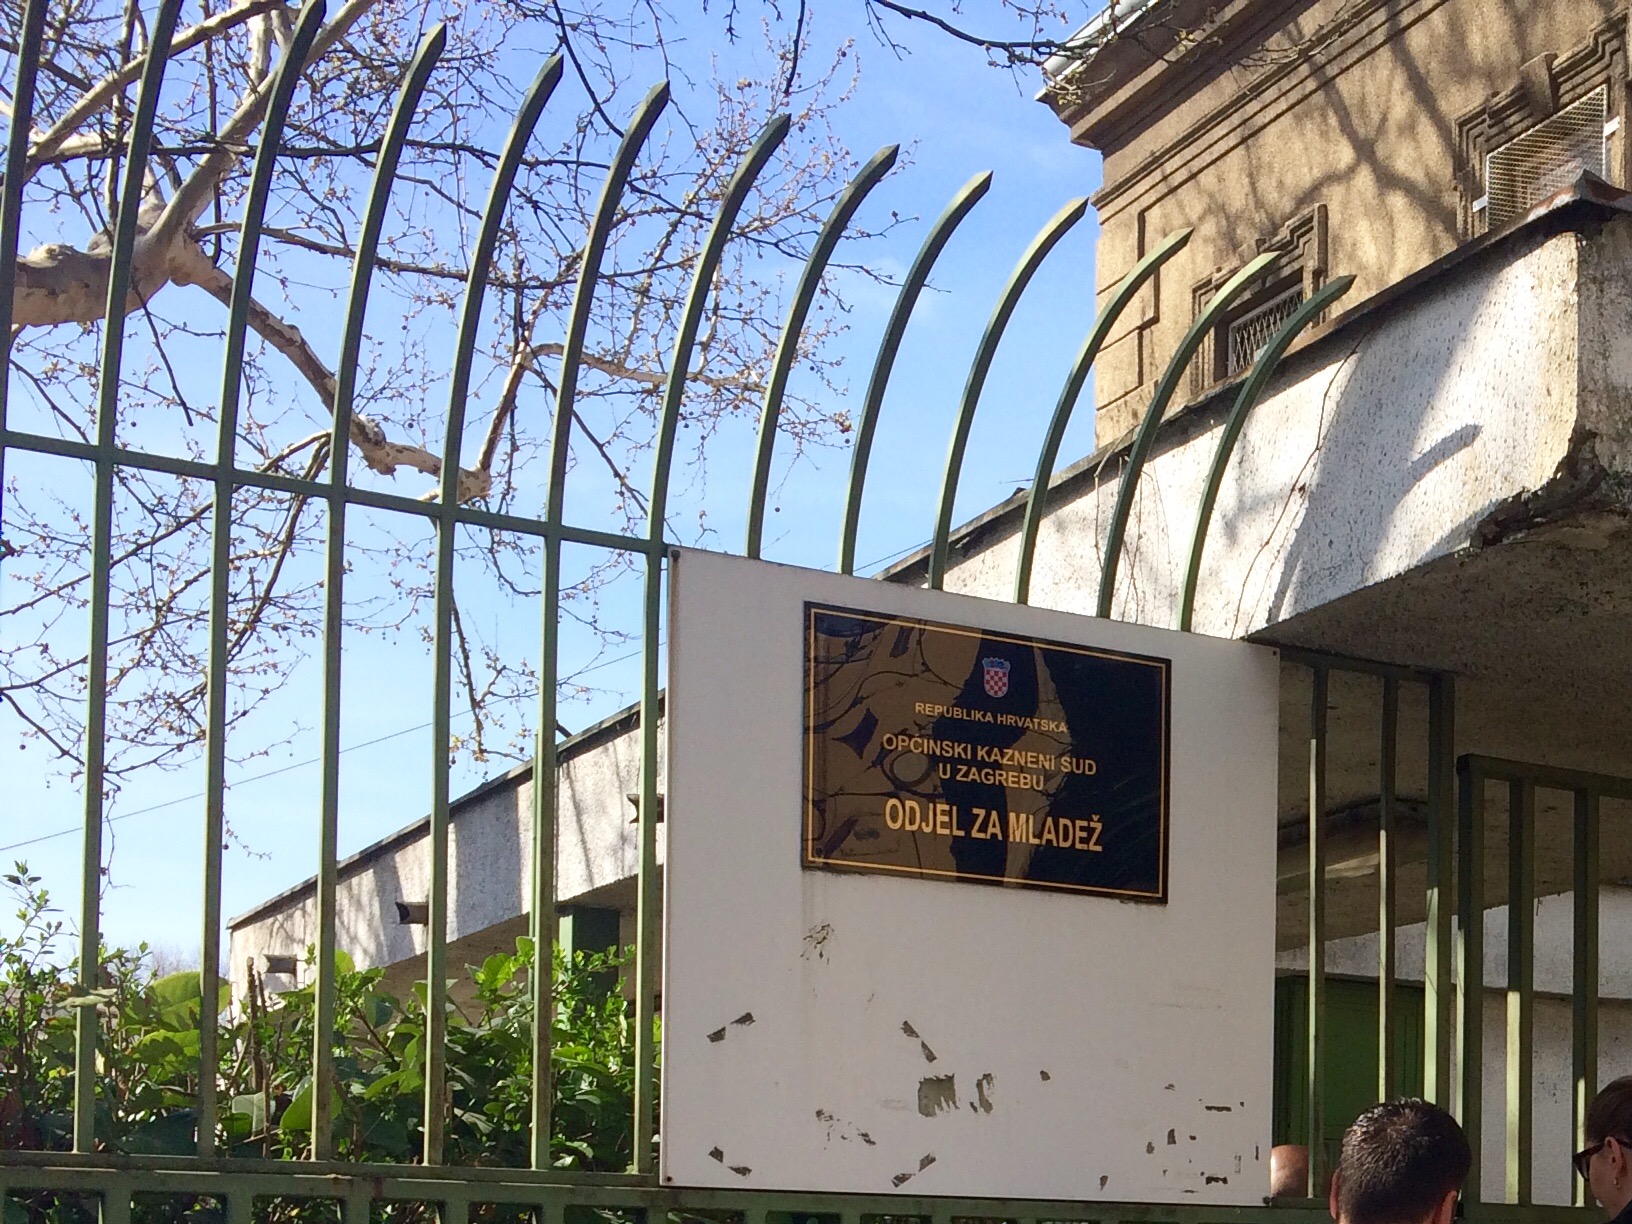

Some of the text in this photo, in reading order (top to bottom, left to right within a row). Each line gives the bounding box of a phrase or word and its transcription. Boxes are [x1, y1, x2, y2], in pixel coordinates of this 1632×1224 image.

[915, 702, 1068, 734] REPUBLIKA HRVATSKA
[882, 733, 1097, 776] OPĆINSKI KAZNENI SUD
[938, 763, 1045, 791] U ZAGREBU
[885, 798, 1103, 853] ODJEL ZA MLADEŽ
